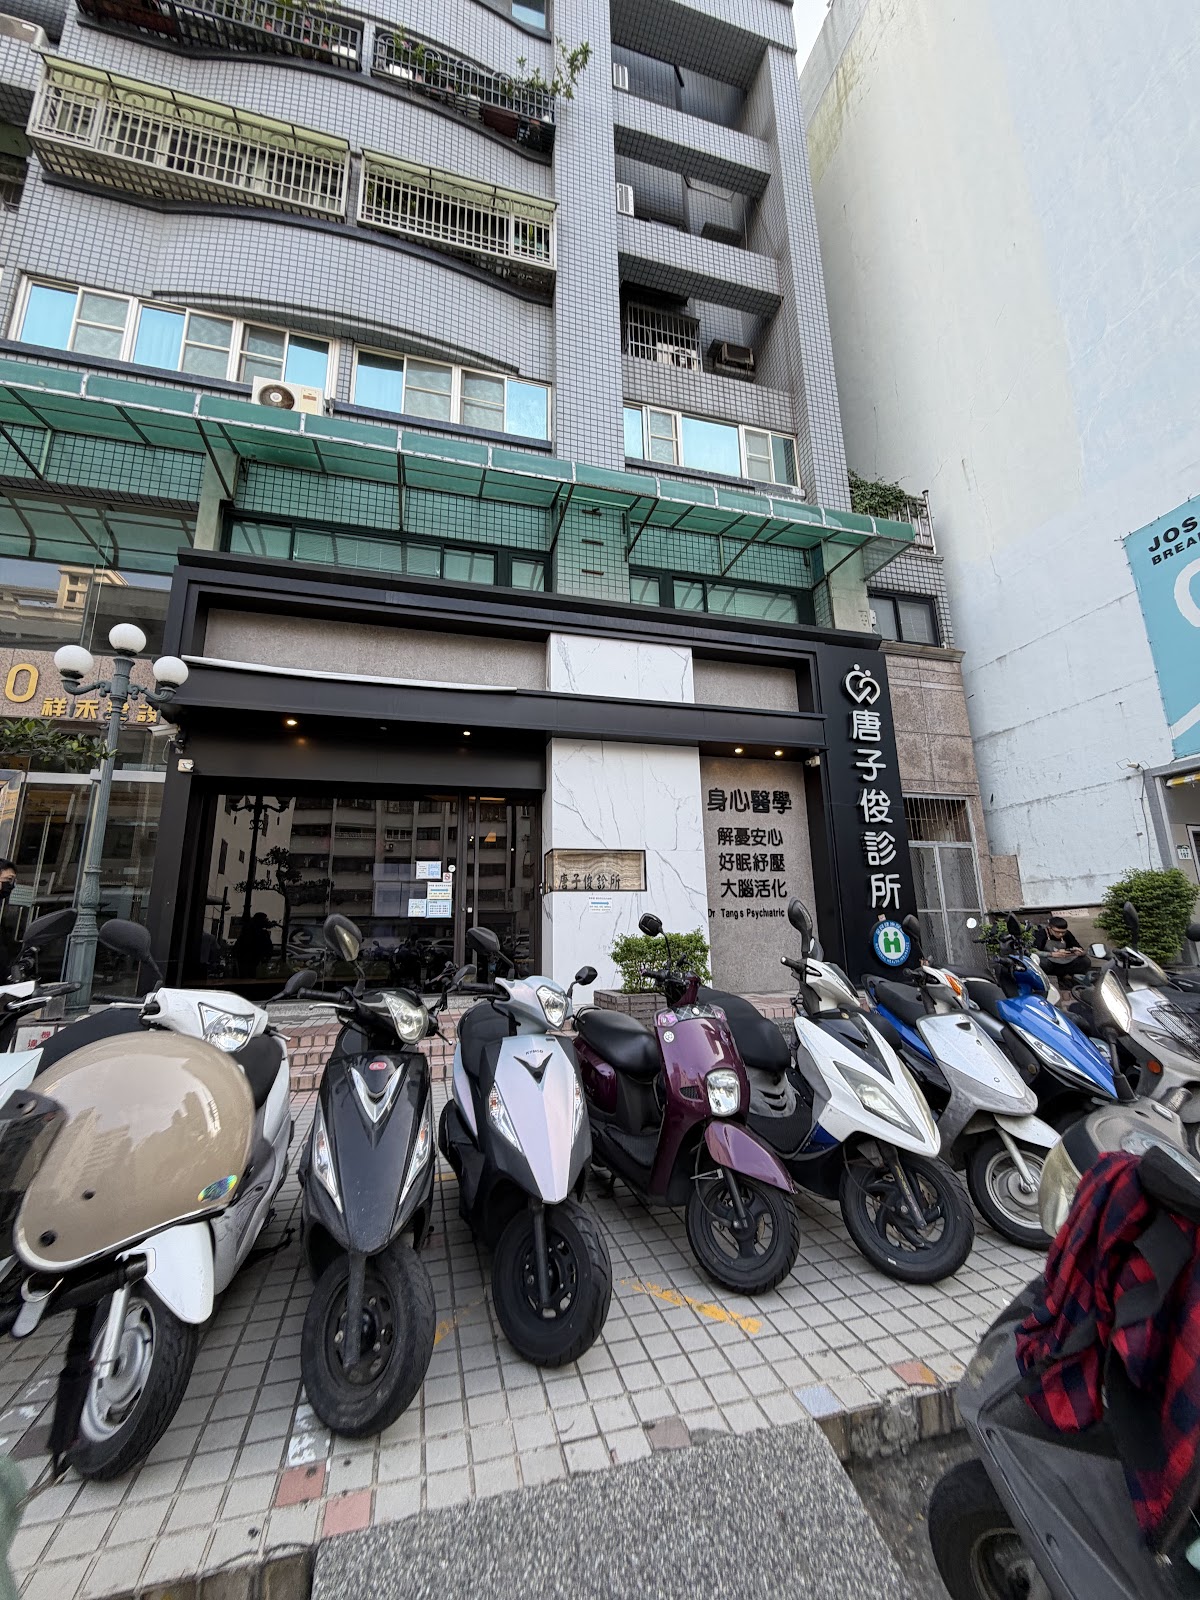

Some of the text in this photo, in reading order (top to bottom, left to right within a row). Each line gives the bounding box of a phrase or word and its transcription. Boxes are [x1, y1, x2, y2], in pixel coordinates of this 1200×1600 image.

[1148, 516, 1198, 552] JOS
[1151, 531, 1200, 566] BREA
[707, 787, 792, 814] 身心醫學
[850, 709, 901, 910] 唐子俊診所
[717, 827, 783, 846] 解憂安心
[718, 852, 786, 872] 好眠紓壓
[558, 872, 621, 890] 唐子俊診所
[720, 878, 788, 898] 大腦活化
